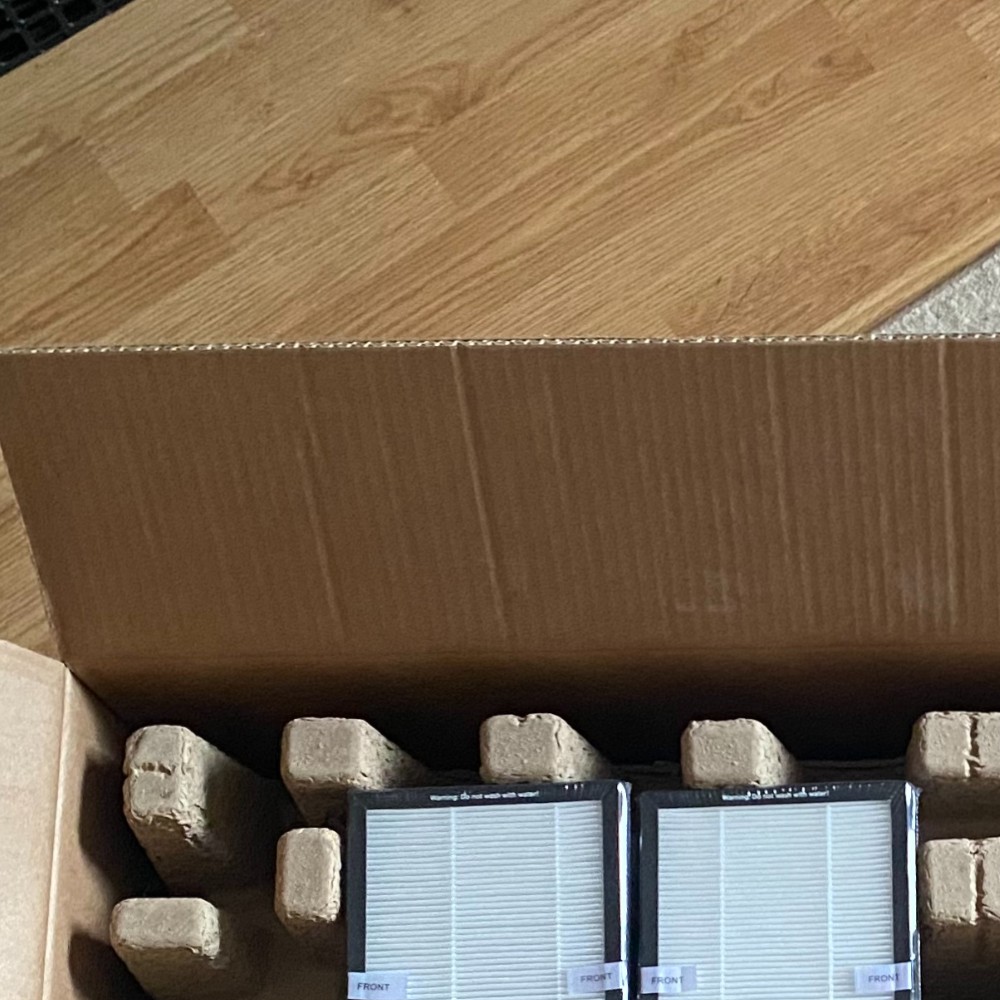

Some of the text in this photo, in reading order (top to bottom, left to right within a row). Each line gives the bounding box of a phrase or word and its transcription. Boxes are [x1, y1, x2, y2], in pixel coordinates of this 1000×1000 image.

[580, 972, 613, 983] FRONT
[651, 976, 685, 985] FRONT
[868, 973, 899, 983] FRONT
[357, 982, 391, 991] FRONT
